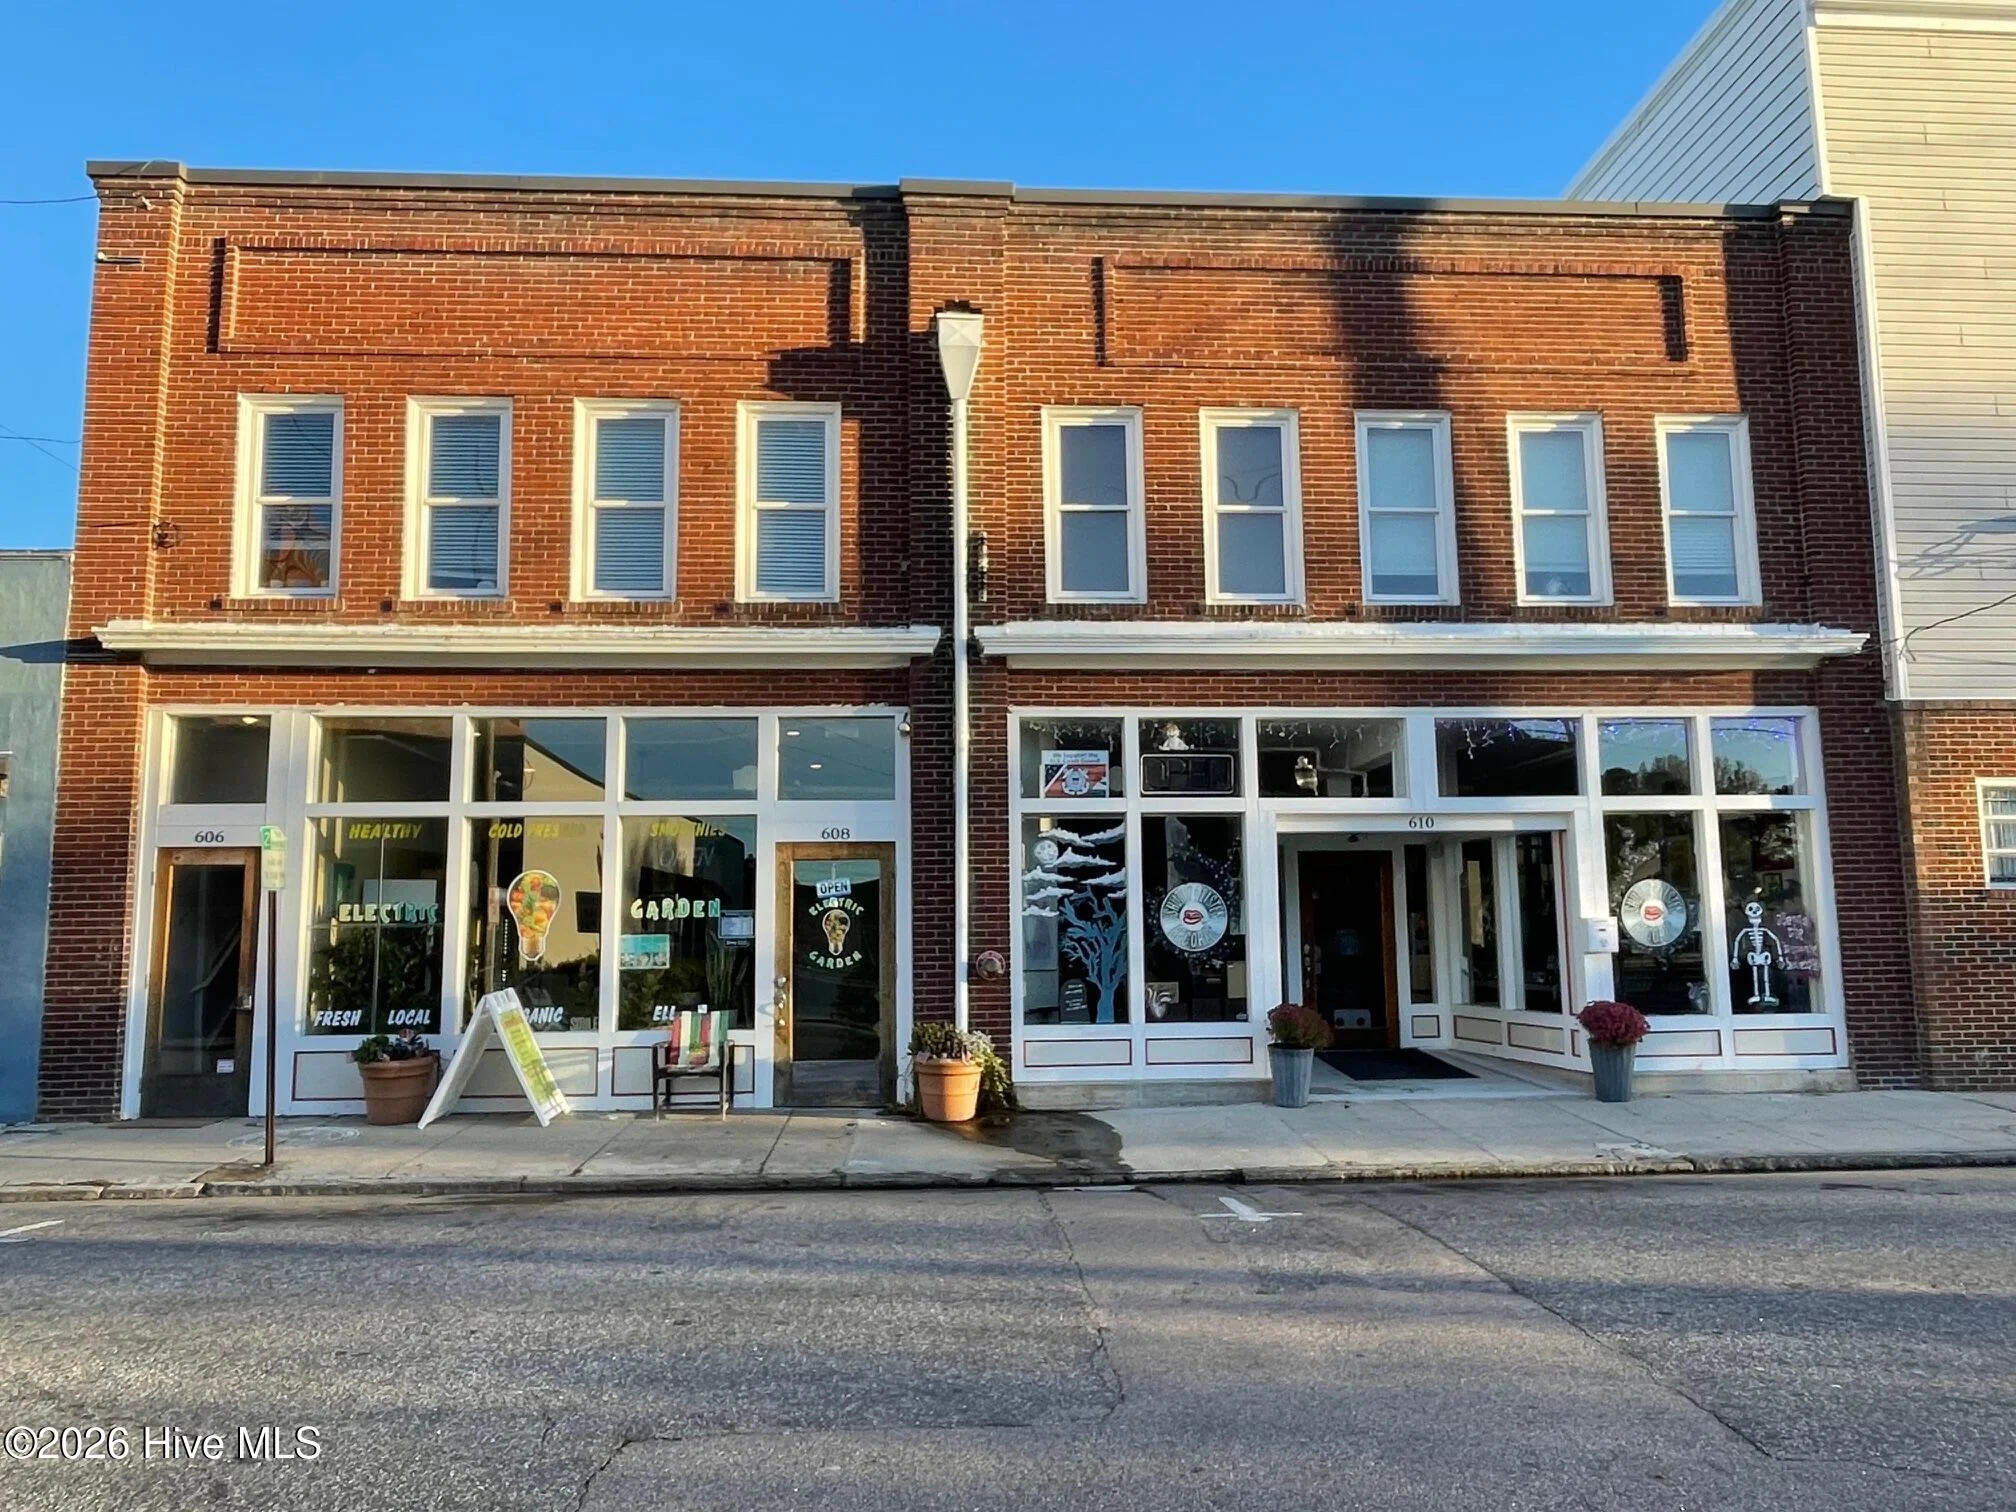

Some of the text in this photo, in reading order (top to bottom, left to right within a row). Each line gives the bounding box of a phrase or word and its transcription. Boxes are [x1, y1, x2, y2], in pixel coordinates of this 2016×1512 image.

[348, 823, 422, 839] HEALTHY
[488, 822, 523, 839] COLD
[1408, 816, 1435, 829] 610
[194, 830, 225, 843] 606
[263, 830, 271, 848] 2
[821, 827, 851, 840] 608
[819, 880, 848, 895] OPEN
[338, 902, 439, 924] ELECTRIC
[630, 897, 720, 921] GARDEN
[809, 950, 863, 970] GARDEN
[313, 1008, 431, 1027] FRESH LOCAL
